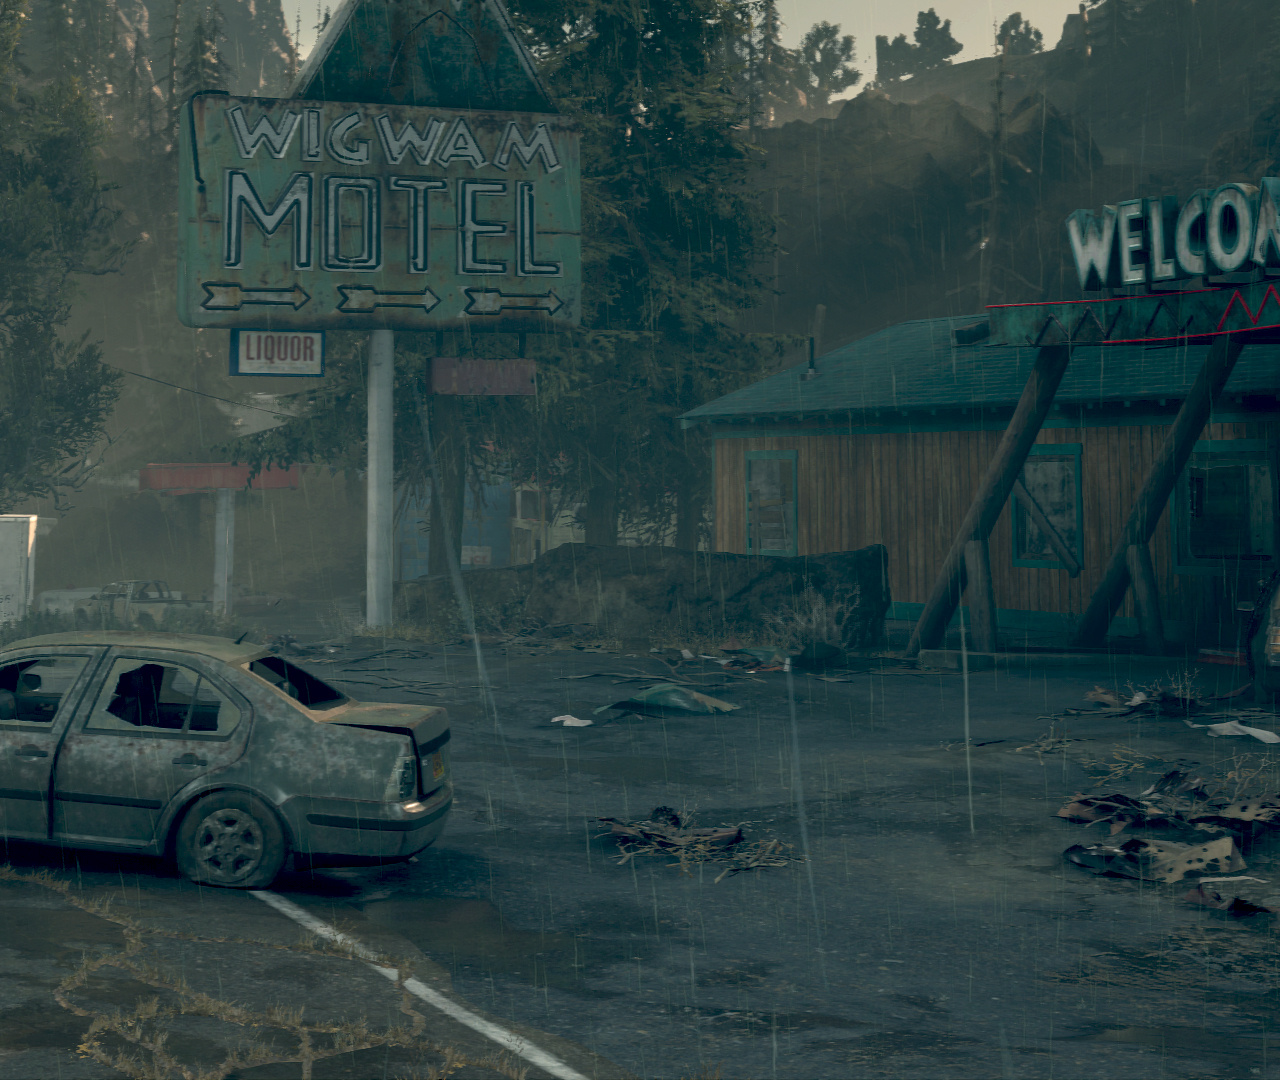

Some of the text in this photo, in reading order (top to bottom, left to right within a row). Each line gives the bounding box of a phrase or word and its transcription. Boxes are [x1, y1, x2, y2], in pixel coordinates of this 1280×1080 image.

[225, 105, 562, 174] WIGWAM
[223, 167, 563, 277] MOTEL
[245, 334, 315, 364] LIQUOR
